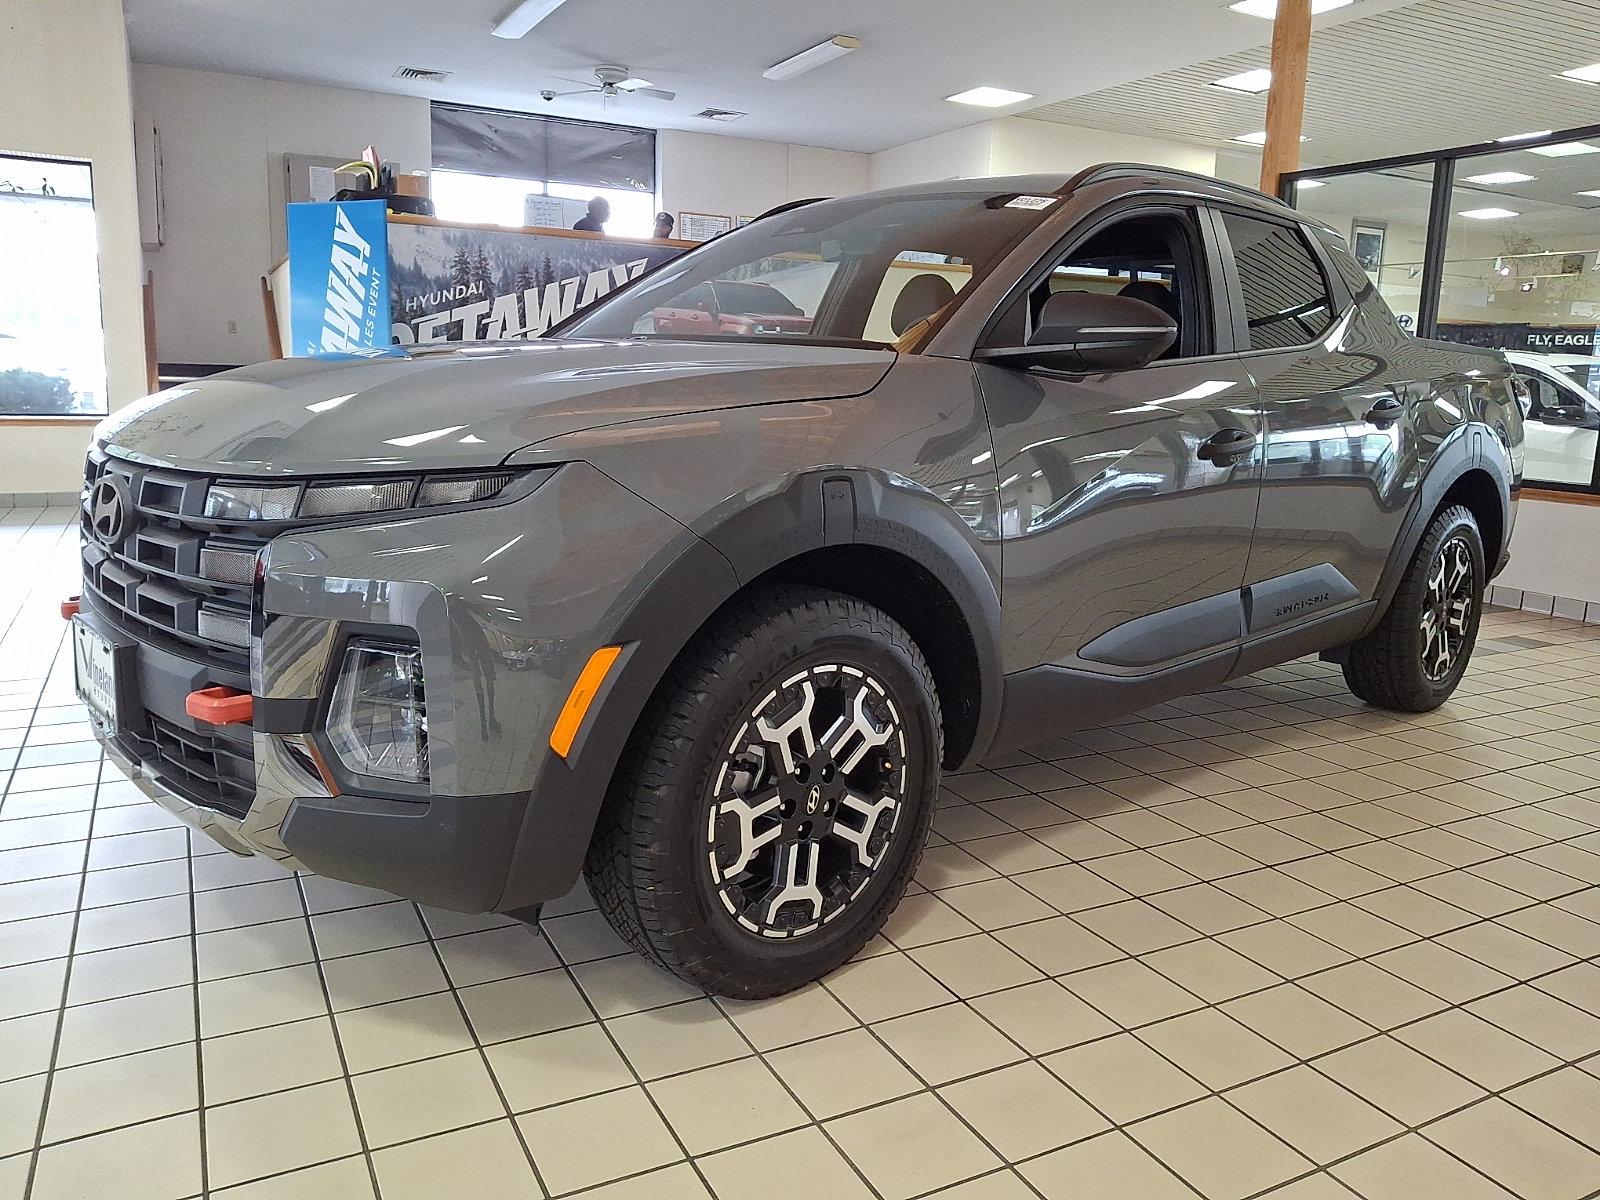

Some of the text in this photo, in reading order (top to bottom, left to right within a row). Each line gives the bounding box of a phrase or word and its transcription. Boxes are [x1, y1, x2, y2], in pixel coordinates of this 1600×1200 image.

[368, 266, 381, 317] EVENT
[405, 280, 484, 312] HYUNDAI
[1527, 334, 1552, 347] FLY,
[79, 636, 114, 699] Vinelan
